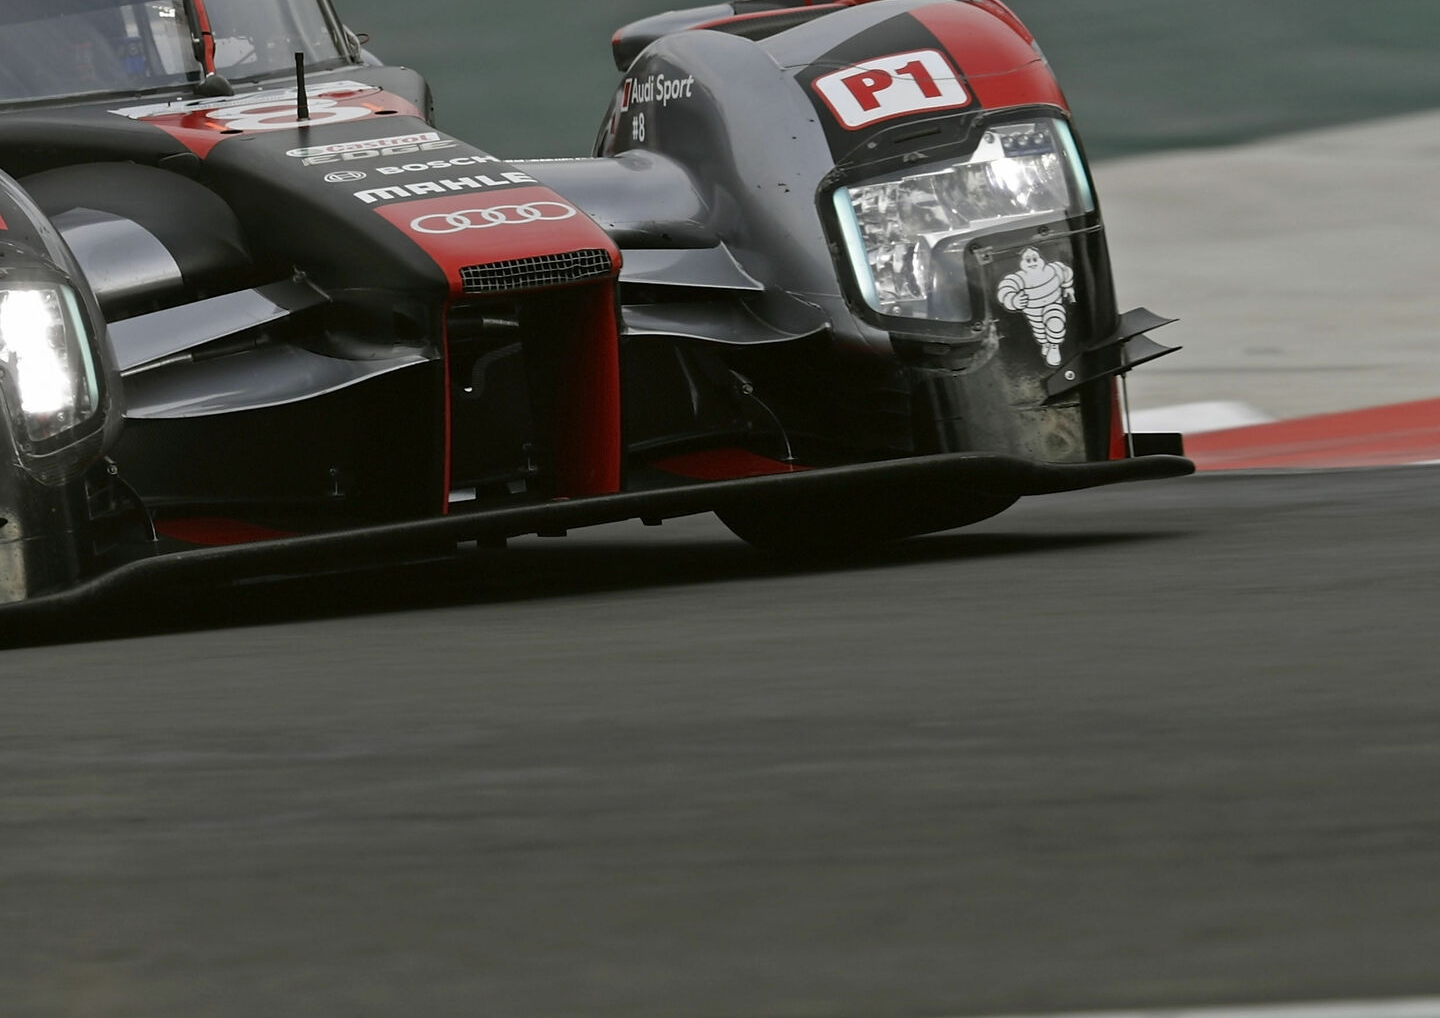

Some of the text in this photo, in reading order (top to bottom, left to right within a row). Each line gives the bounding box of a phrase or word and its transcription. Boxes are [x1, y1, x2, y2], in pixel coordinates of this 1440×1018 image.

[631, 73, 694, 107] Audi Sport
[840, 59, 943, 112] P1
[205, 98, 373, 131] 8
[632, 112, 645, 143] #8
[301, 139, 458, 167] EDGE
[325, 133, 429, 153] Castrol
[376, 154, 502, 176] BOSCH
[353, 171, 539, 204] MAHLE
